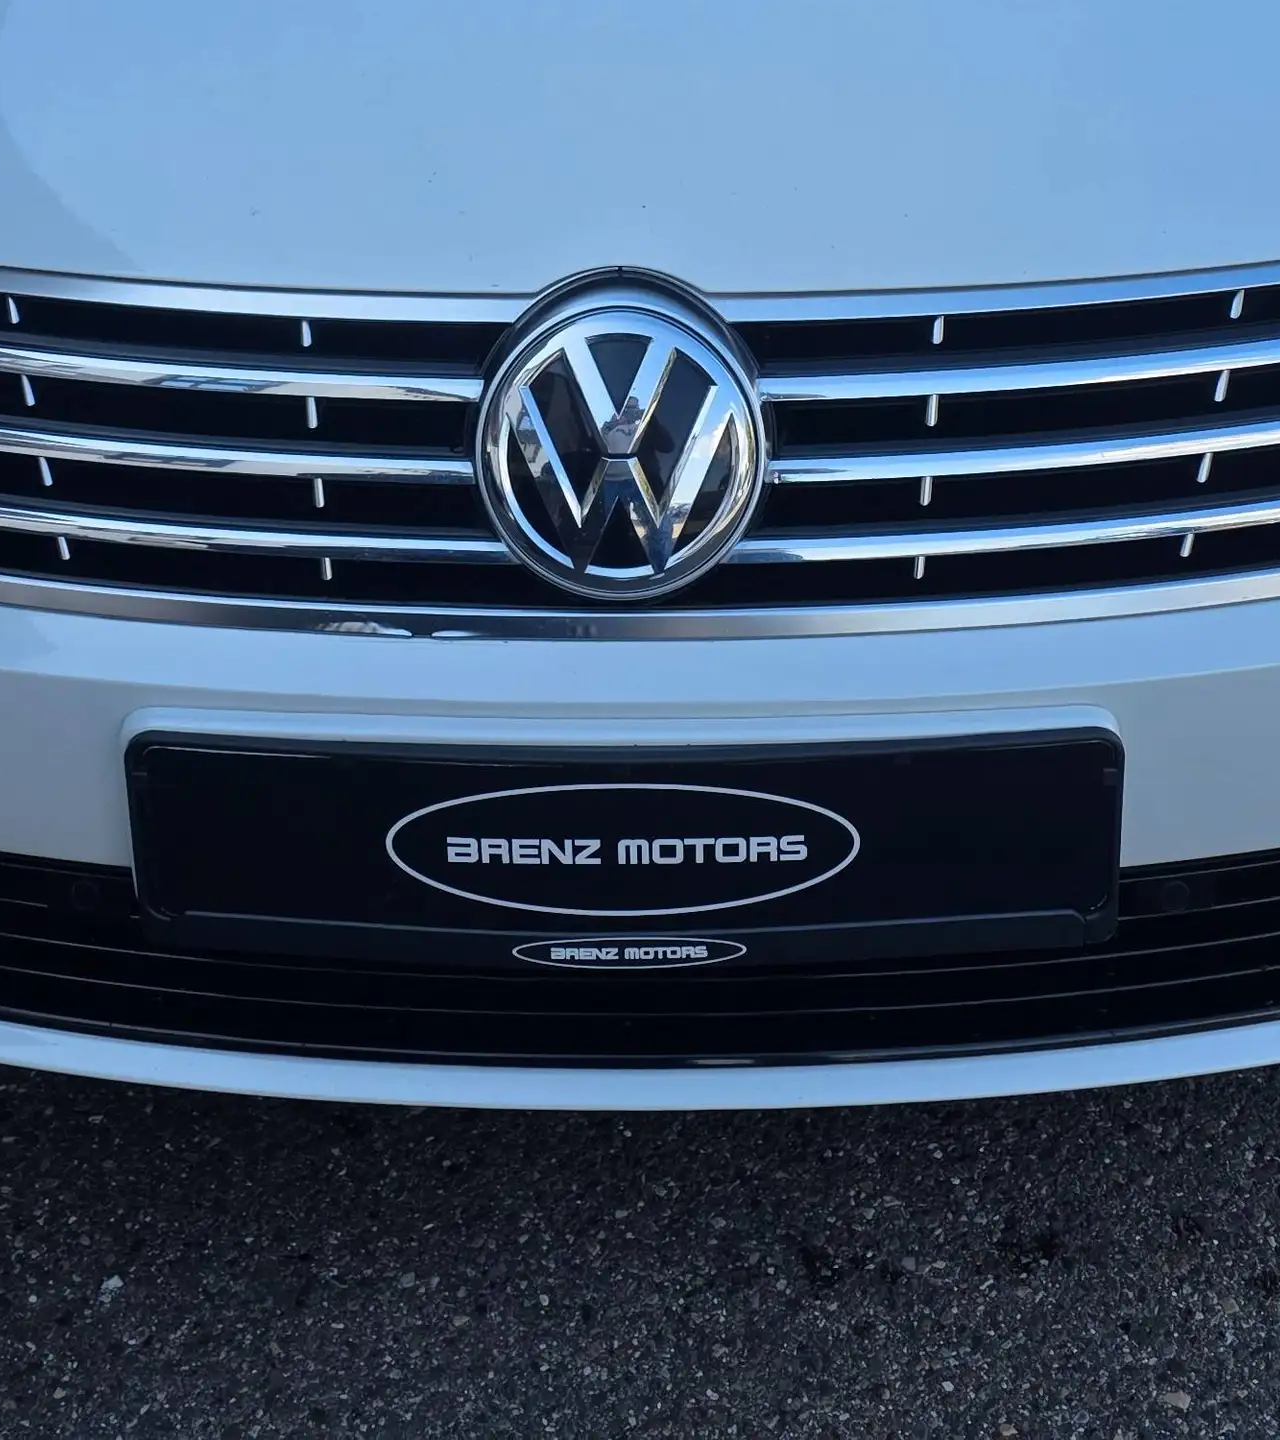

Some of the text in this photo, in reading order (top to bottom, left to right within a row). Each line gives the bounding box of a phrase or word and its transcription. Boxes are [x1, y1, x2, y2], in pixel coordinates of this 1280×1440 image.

[445, 834, 808, 866] BRENZ MOTORS
[550, 945, 708, 960] BRENZ MOTORS
